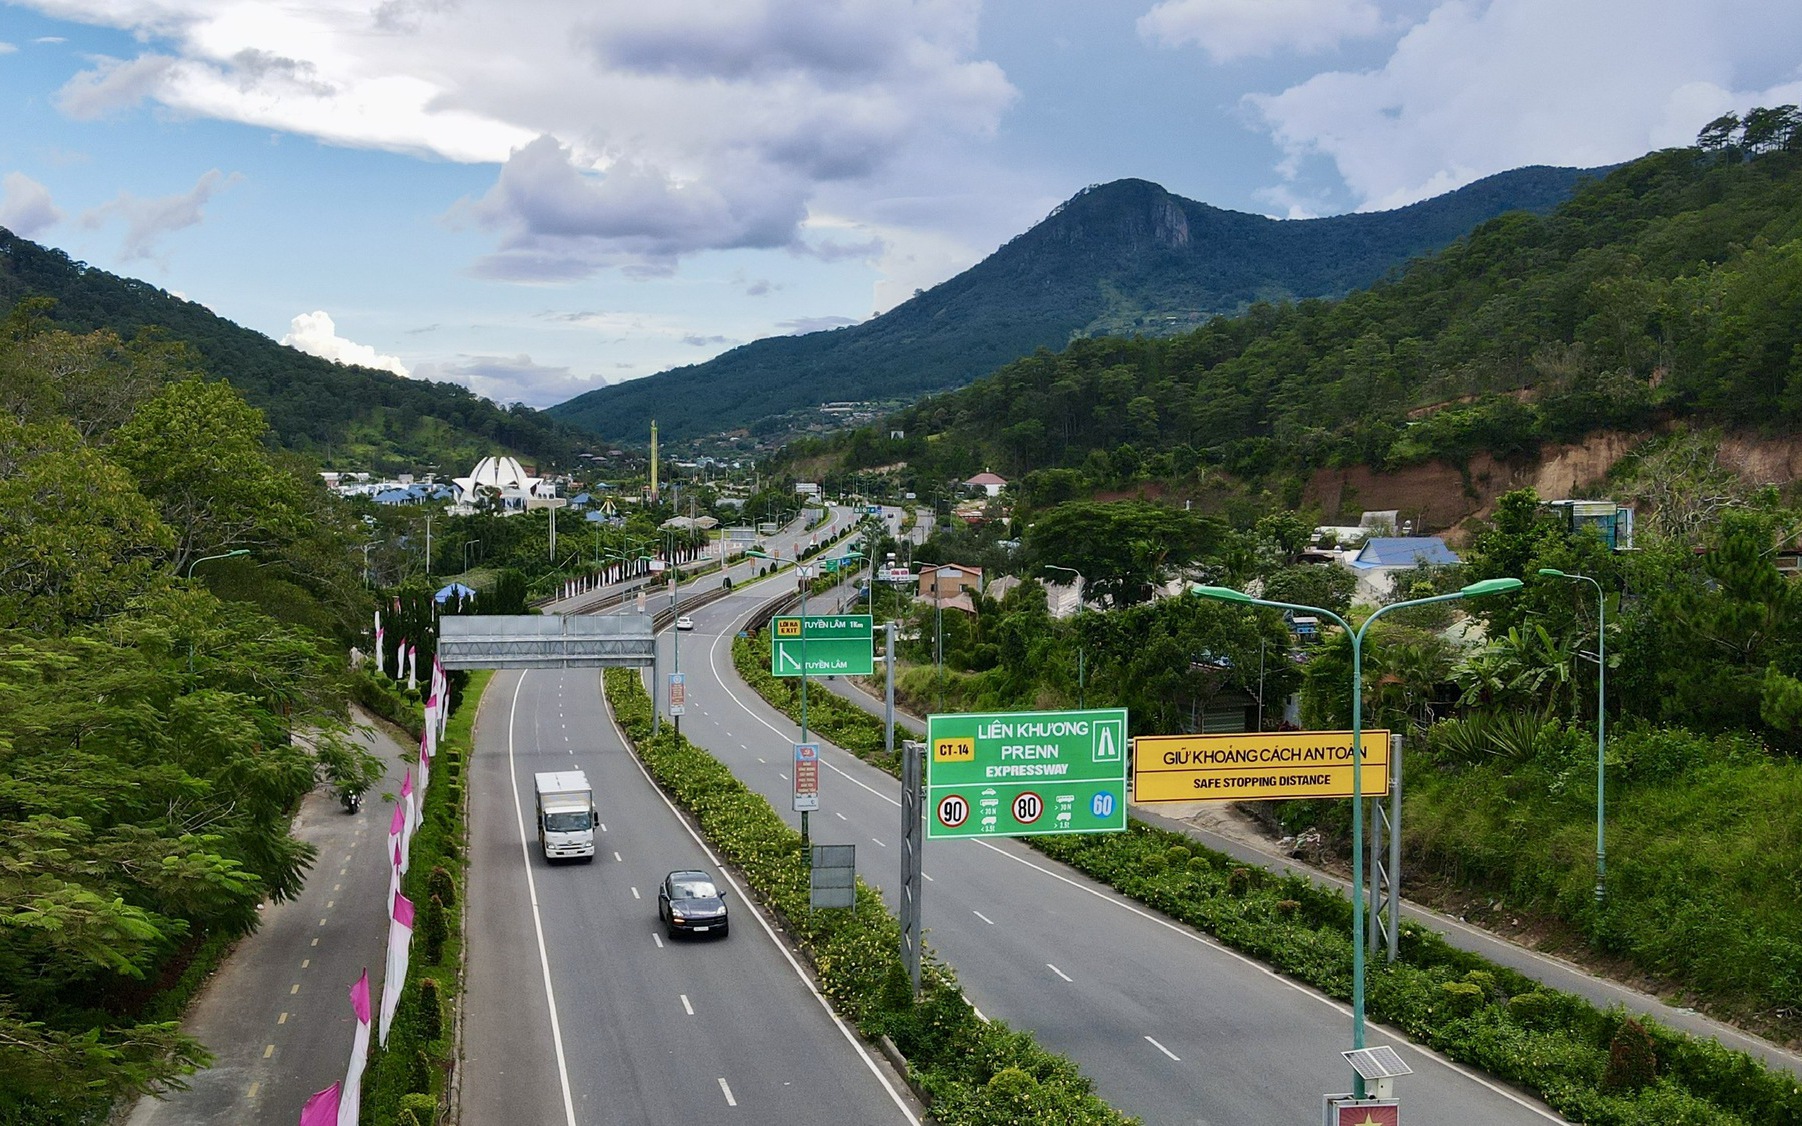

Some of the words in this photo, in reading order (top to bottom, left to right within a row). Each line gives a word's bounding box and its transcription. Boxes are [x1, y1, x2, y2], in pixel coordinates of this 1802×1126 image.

[978, 720, 1013, 739] LIÊN
[1017, 721, 1088, 738] KHƯƠNG
[1001, 745, 1059, 760] PRENN
[1164, 747, 1191, 765] GIỮ
[1260, 746, 1301, 762] CÁCH
[1303, 748, 1325, 760] AN
[986, 764, 1068, 777] EXPRESSWAY
[1194, 778, 1221, 789] SAFE
[1223, 776, 1276, 788] STOPPING
[1279, 775, 1331, 786] DISTANCE
[944, 801, 962, 822] 90
[1018, 797, 1035, 818] 80
[1093, 795, 1112, 816] 60
